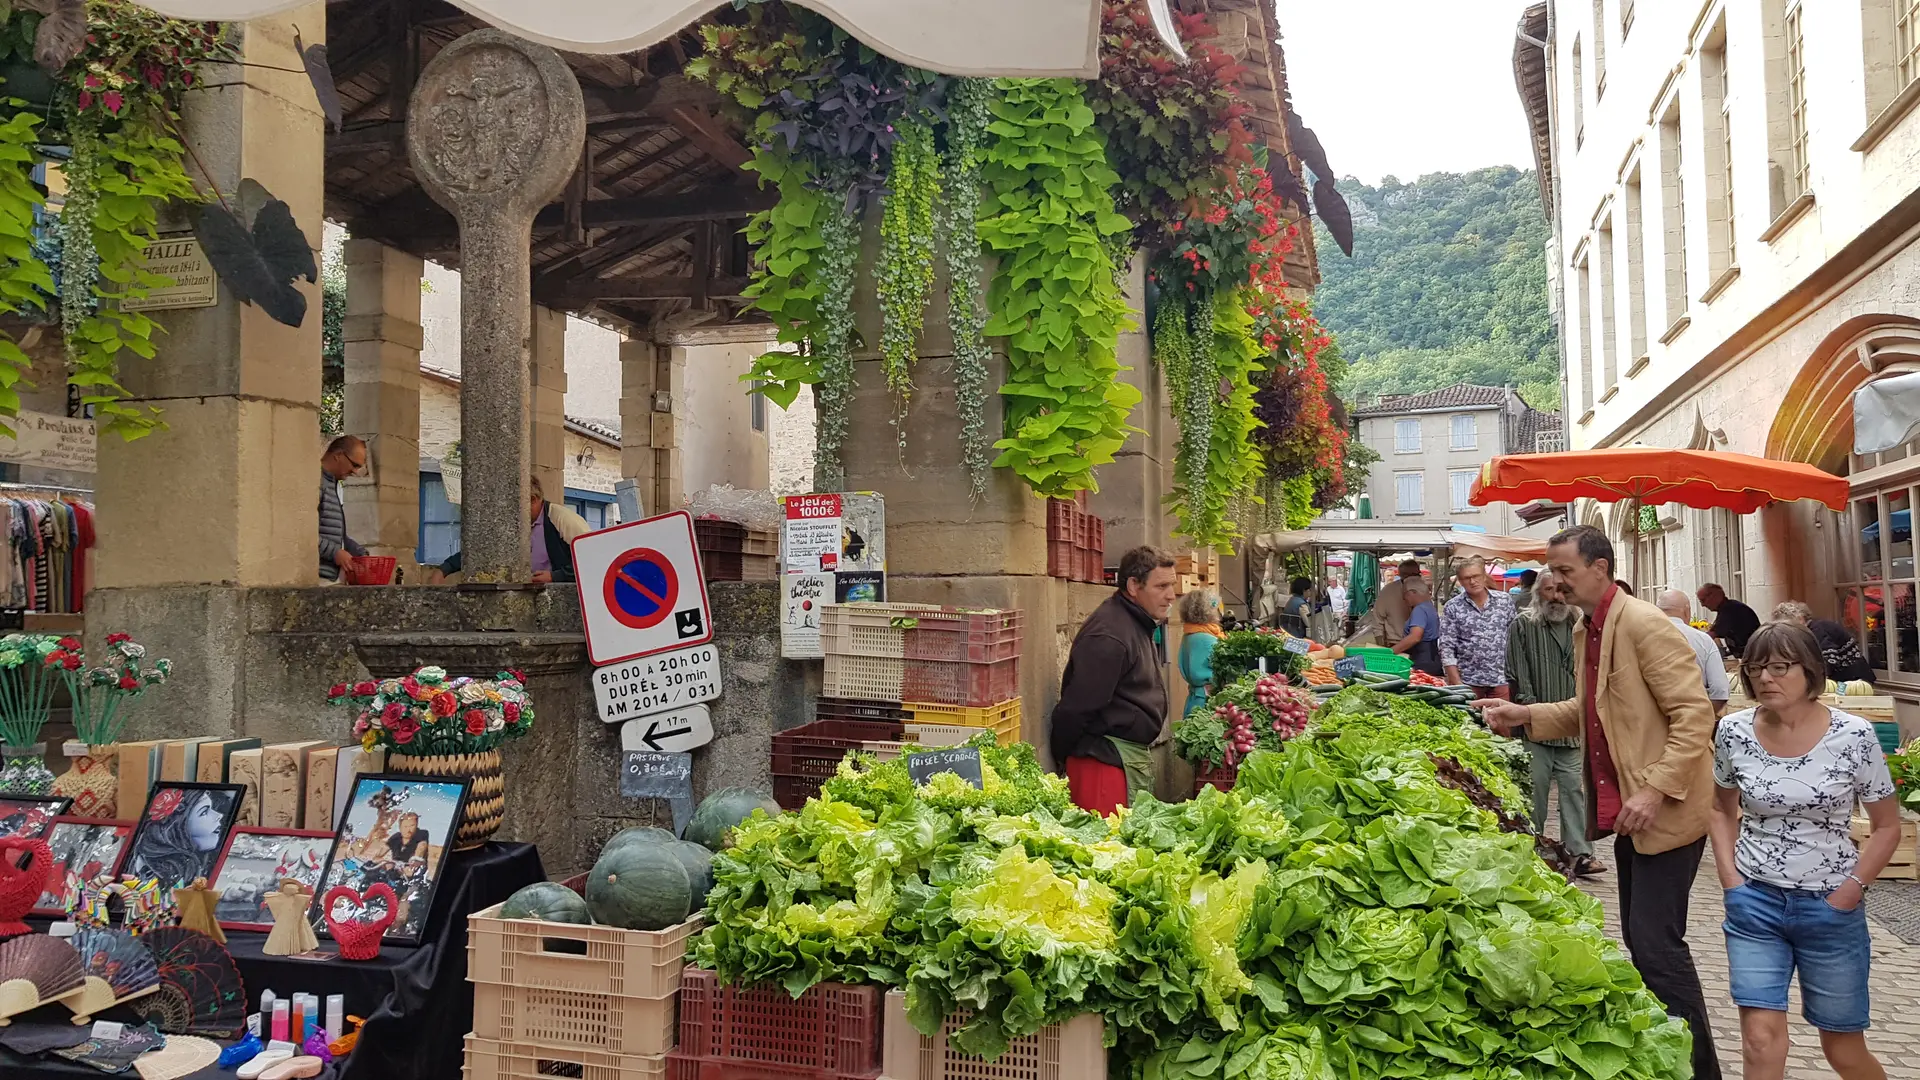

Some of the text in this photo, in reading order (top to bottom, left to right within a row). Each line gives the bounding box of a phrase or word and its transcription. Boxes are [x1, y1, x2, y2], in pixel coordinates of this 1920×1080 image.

[176, 275, 210, 287] habitants
[800, 497, 820, 507] Jeu
[799, 505, 835, 517] 1000€
[796, 576, 825, 589] atelier
[600, 666, 640, 685] 8h00
[659, 650, 711, 672] 20h00
[607, 701, 628, 717] AM
[633, 692, 668, 711] 2014
